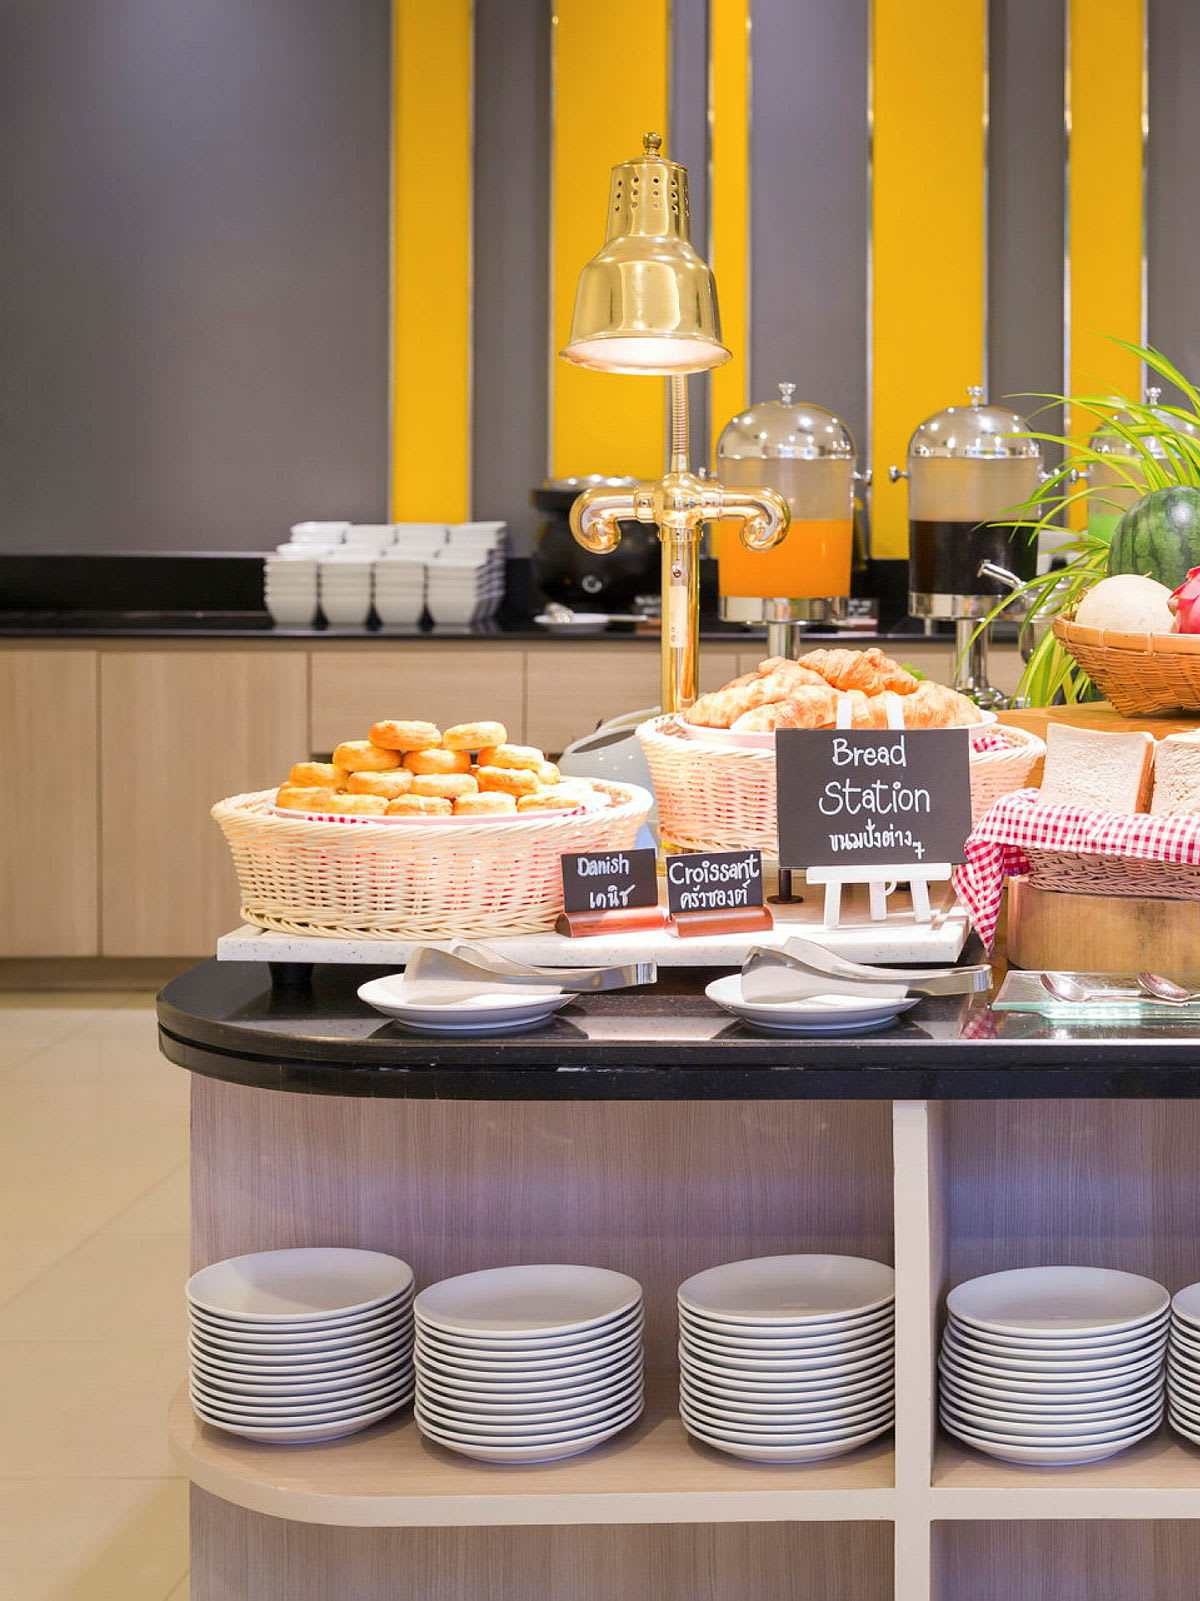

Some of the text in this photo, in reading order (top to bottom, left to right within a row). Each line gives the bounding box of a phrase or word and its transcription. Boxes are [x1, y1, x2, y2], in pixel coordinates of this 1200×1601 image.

[832, 735, 907, 767] Bread
[818, 778, 931, 816] Station
[577, 853, 630, 878] Danish
[668, 854, 760, 885] Croissant
